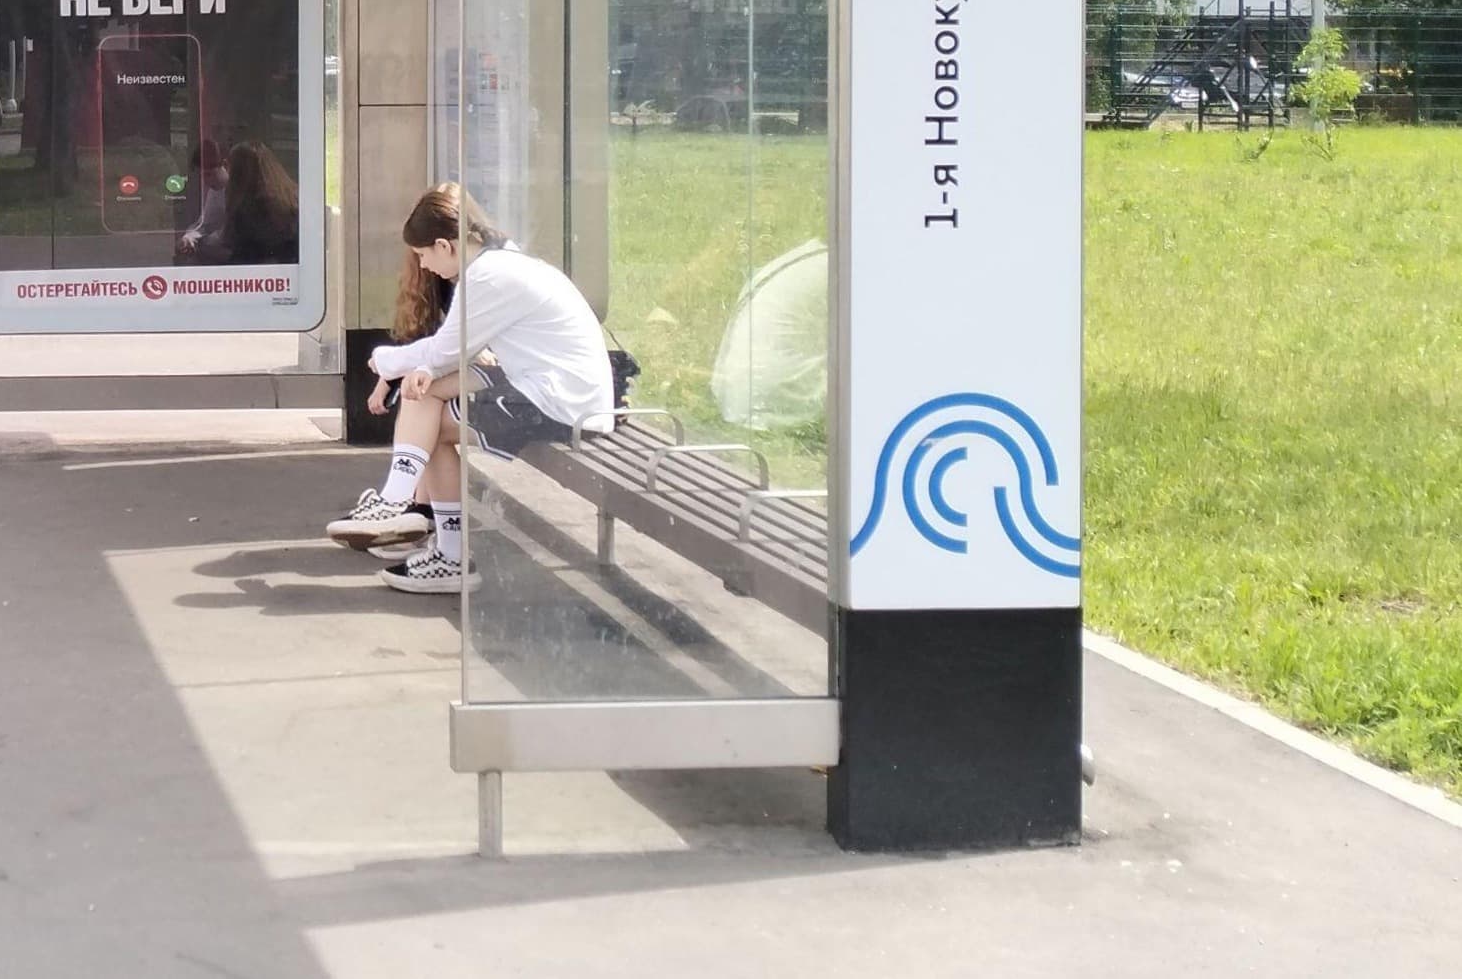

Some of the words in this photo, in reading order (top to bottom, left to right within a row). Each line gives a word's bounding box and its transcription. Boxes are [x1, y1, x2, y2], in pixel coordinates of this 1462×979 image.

[116, 73, 186, 85] Неизвестен
[924, 165, 958, 228] 1-я
[17, 279, 138, 299] ОСТЕРЕГАЙТЕСЬ
[173, 277, 291, 295] МОШЕННИКОВ!
